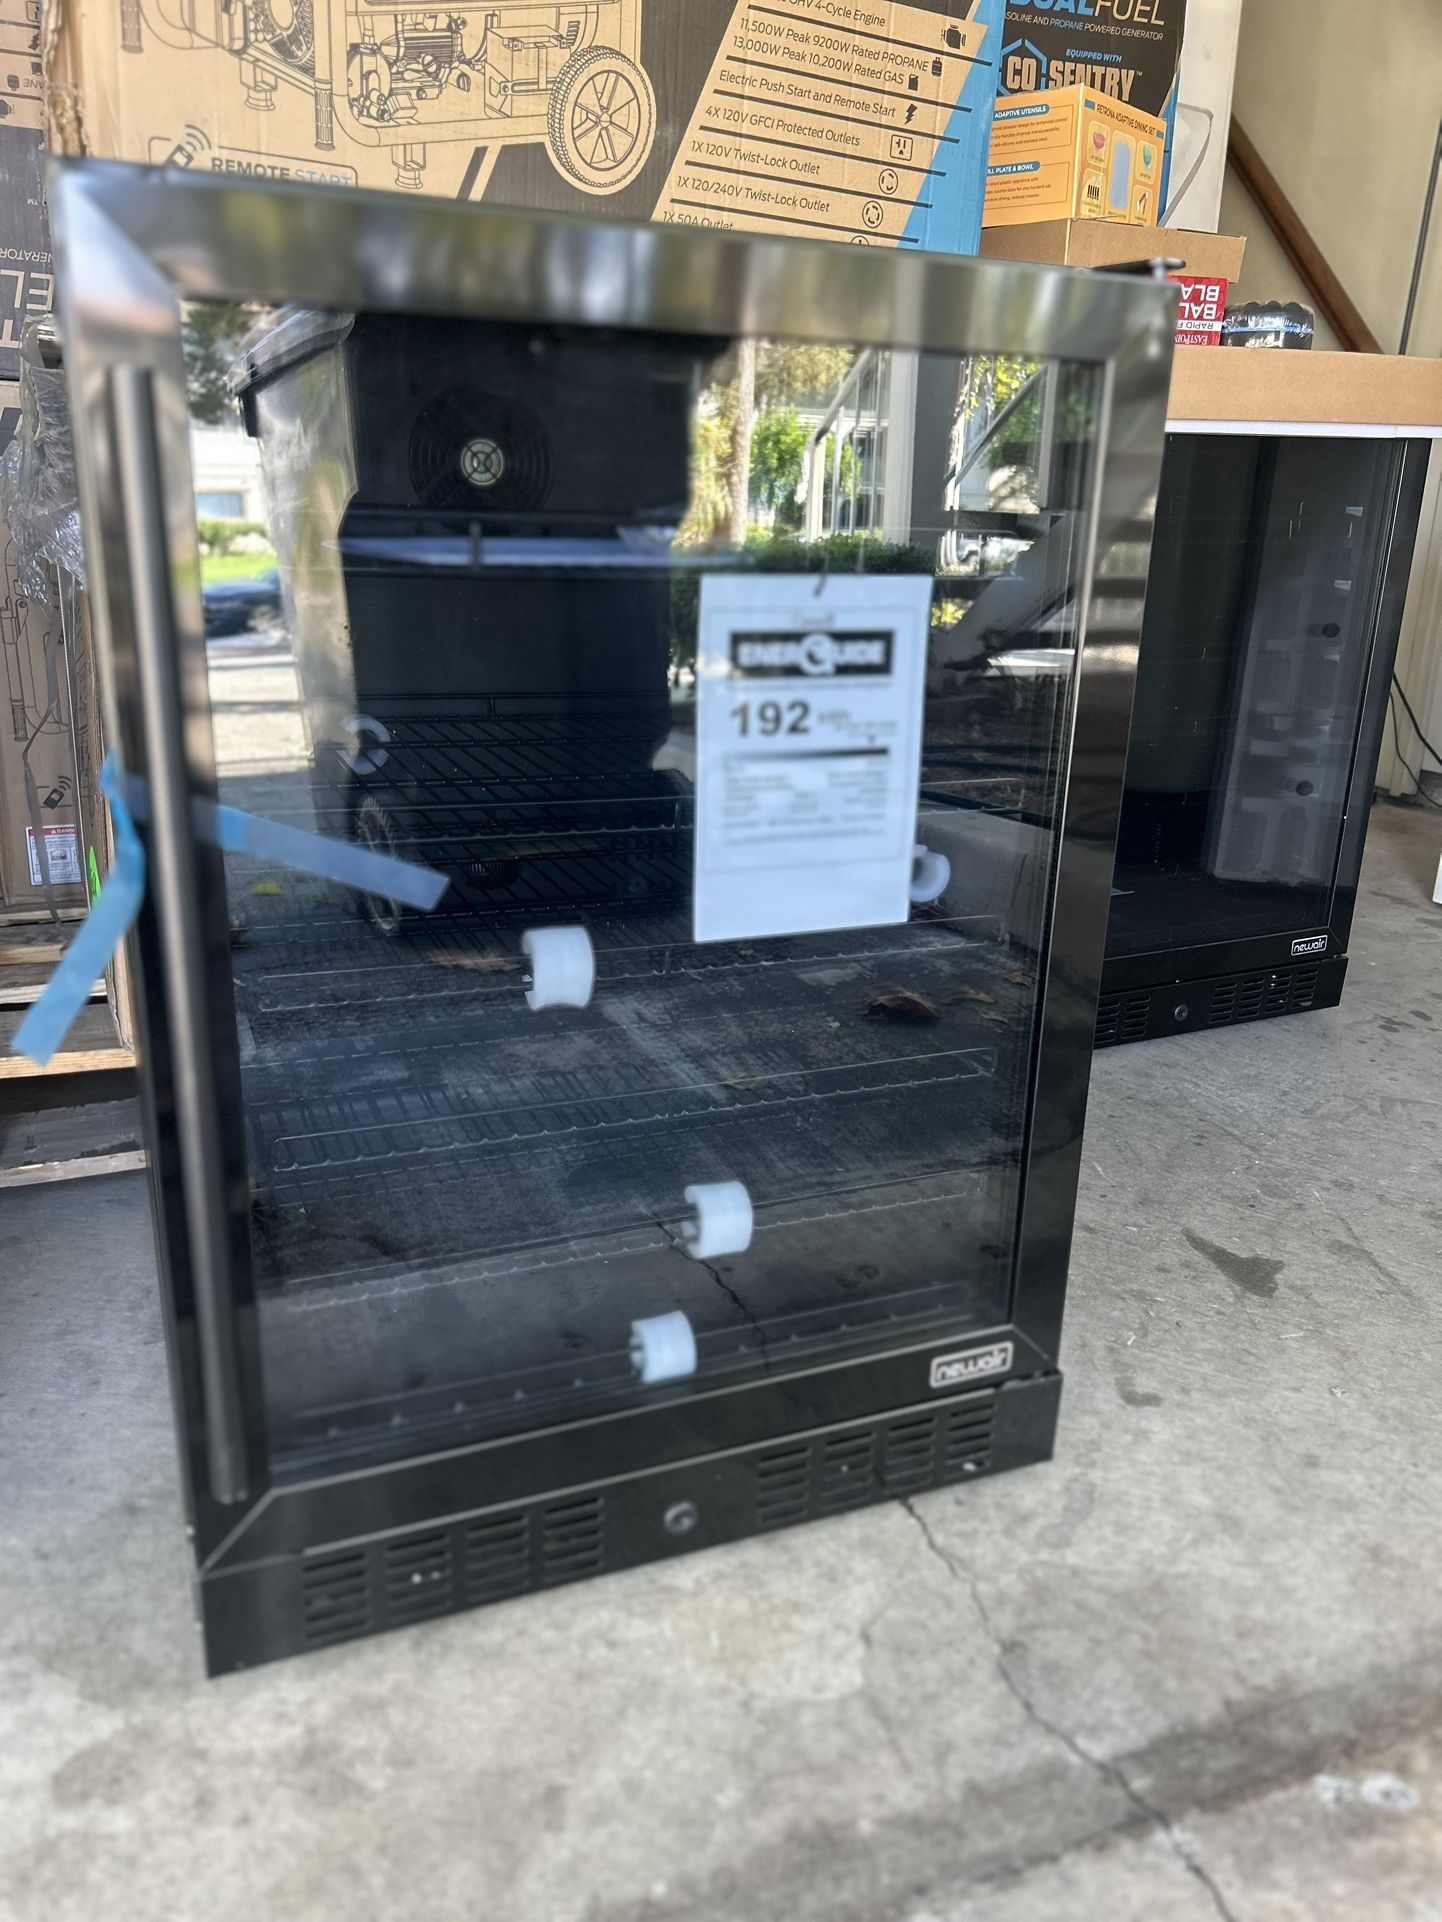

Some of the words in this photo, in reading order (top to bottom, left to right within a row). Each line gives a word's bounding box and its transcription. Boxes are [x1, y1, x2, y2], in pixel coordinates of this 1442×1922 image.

[815, 2, 851, 18] 4-Cycle
[853, 10, 886, 27] Engine
[1005, 11, 1032, 23] SOLINE
[1033, 16, 1049, 26] AND
[1050, 18, 1083, 31] PROPANE
[1084, 23, 1121, 35] POWERED
[1121, 29, 1164, 41] GENERATOR
[733, 35, 781, 56] 13,000W
[782, 47, 807, 63] Peak
[809, 53, 853, 72] 10,200W
[854, 63, 882, 79] Rated
[884, 71, 905, 85] GAS
[740, 18, 785, 37] 11,500W
[786, 28, 811, 44] Peak
[813, 35, 851, 53] 9200W
[852, 44, 880, 60] Rated
[881, 51, 929, 72] PROPANE
[1065, 48, 1102, 61] EQUIPPED
[1103, 53, 1123, 63] WITH
[1006, 55, 1037, 91] CO
[1049, 59, 1135, 101] SENTRY
[719, 69, 757, 88] Electric
[759, 77, 785, 94] Push
[786, 84, 816, 99] Start
[813, 90, 832, 104] and
[833, 95, 870, 112] Remote
[872, 103, 896, 118] Start
[705, 105, 721, 119] 4X
[722, 107, 748, 124] 120V
[750, 114, 774, 129] GFCI
[775, 120, 824, 139] Protected
[825, 130, 860, 146] Outlets
[994, 109, 1020, 118] ADAPTIVE
[1020, 105, 1046, 115] UTENSILS
[211, 157, 290, 180] REMOTE
[295, 168, 352, 187] START
[691, 140, 704, 153] 1X
[705, 143, 732, 158] 120V
[733, 148, 788, 168] Twist-Lock
[789, 159, 820, 175] Outlet
[995, 165, 1011, 174] PLATE
[677, 175, 690, 188] 1X
[691, 177, 743, 197] 120/240V
[745, 187, 797, 207] Twist-Lock
[799, 197, 830, 213] Outlet
[663, 211, 675, 223] 1X
[700, 217, 734, 231] Outlet
[1181, 283, 1220, 302] BLA
[1179, 302, 1217, 320] BAL
[1186, 321, 1213, 330] RAPID
[730, 699, 811, 737] 192
[1293, 938, 1325, 953] newair
[935, 1346, 1007, 1380] newair
